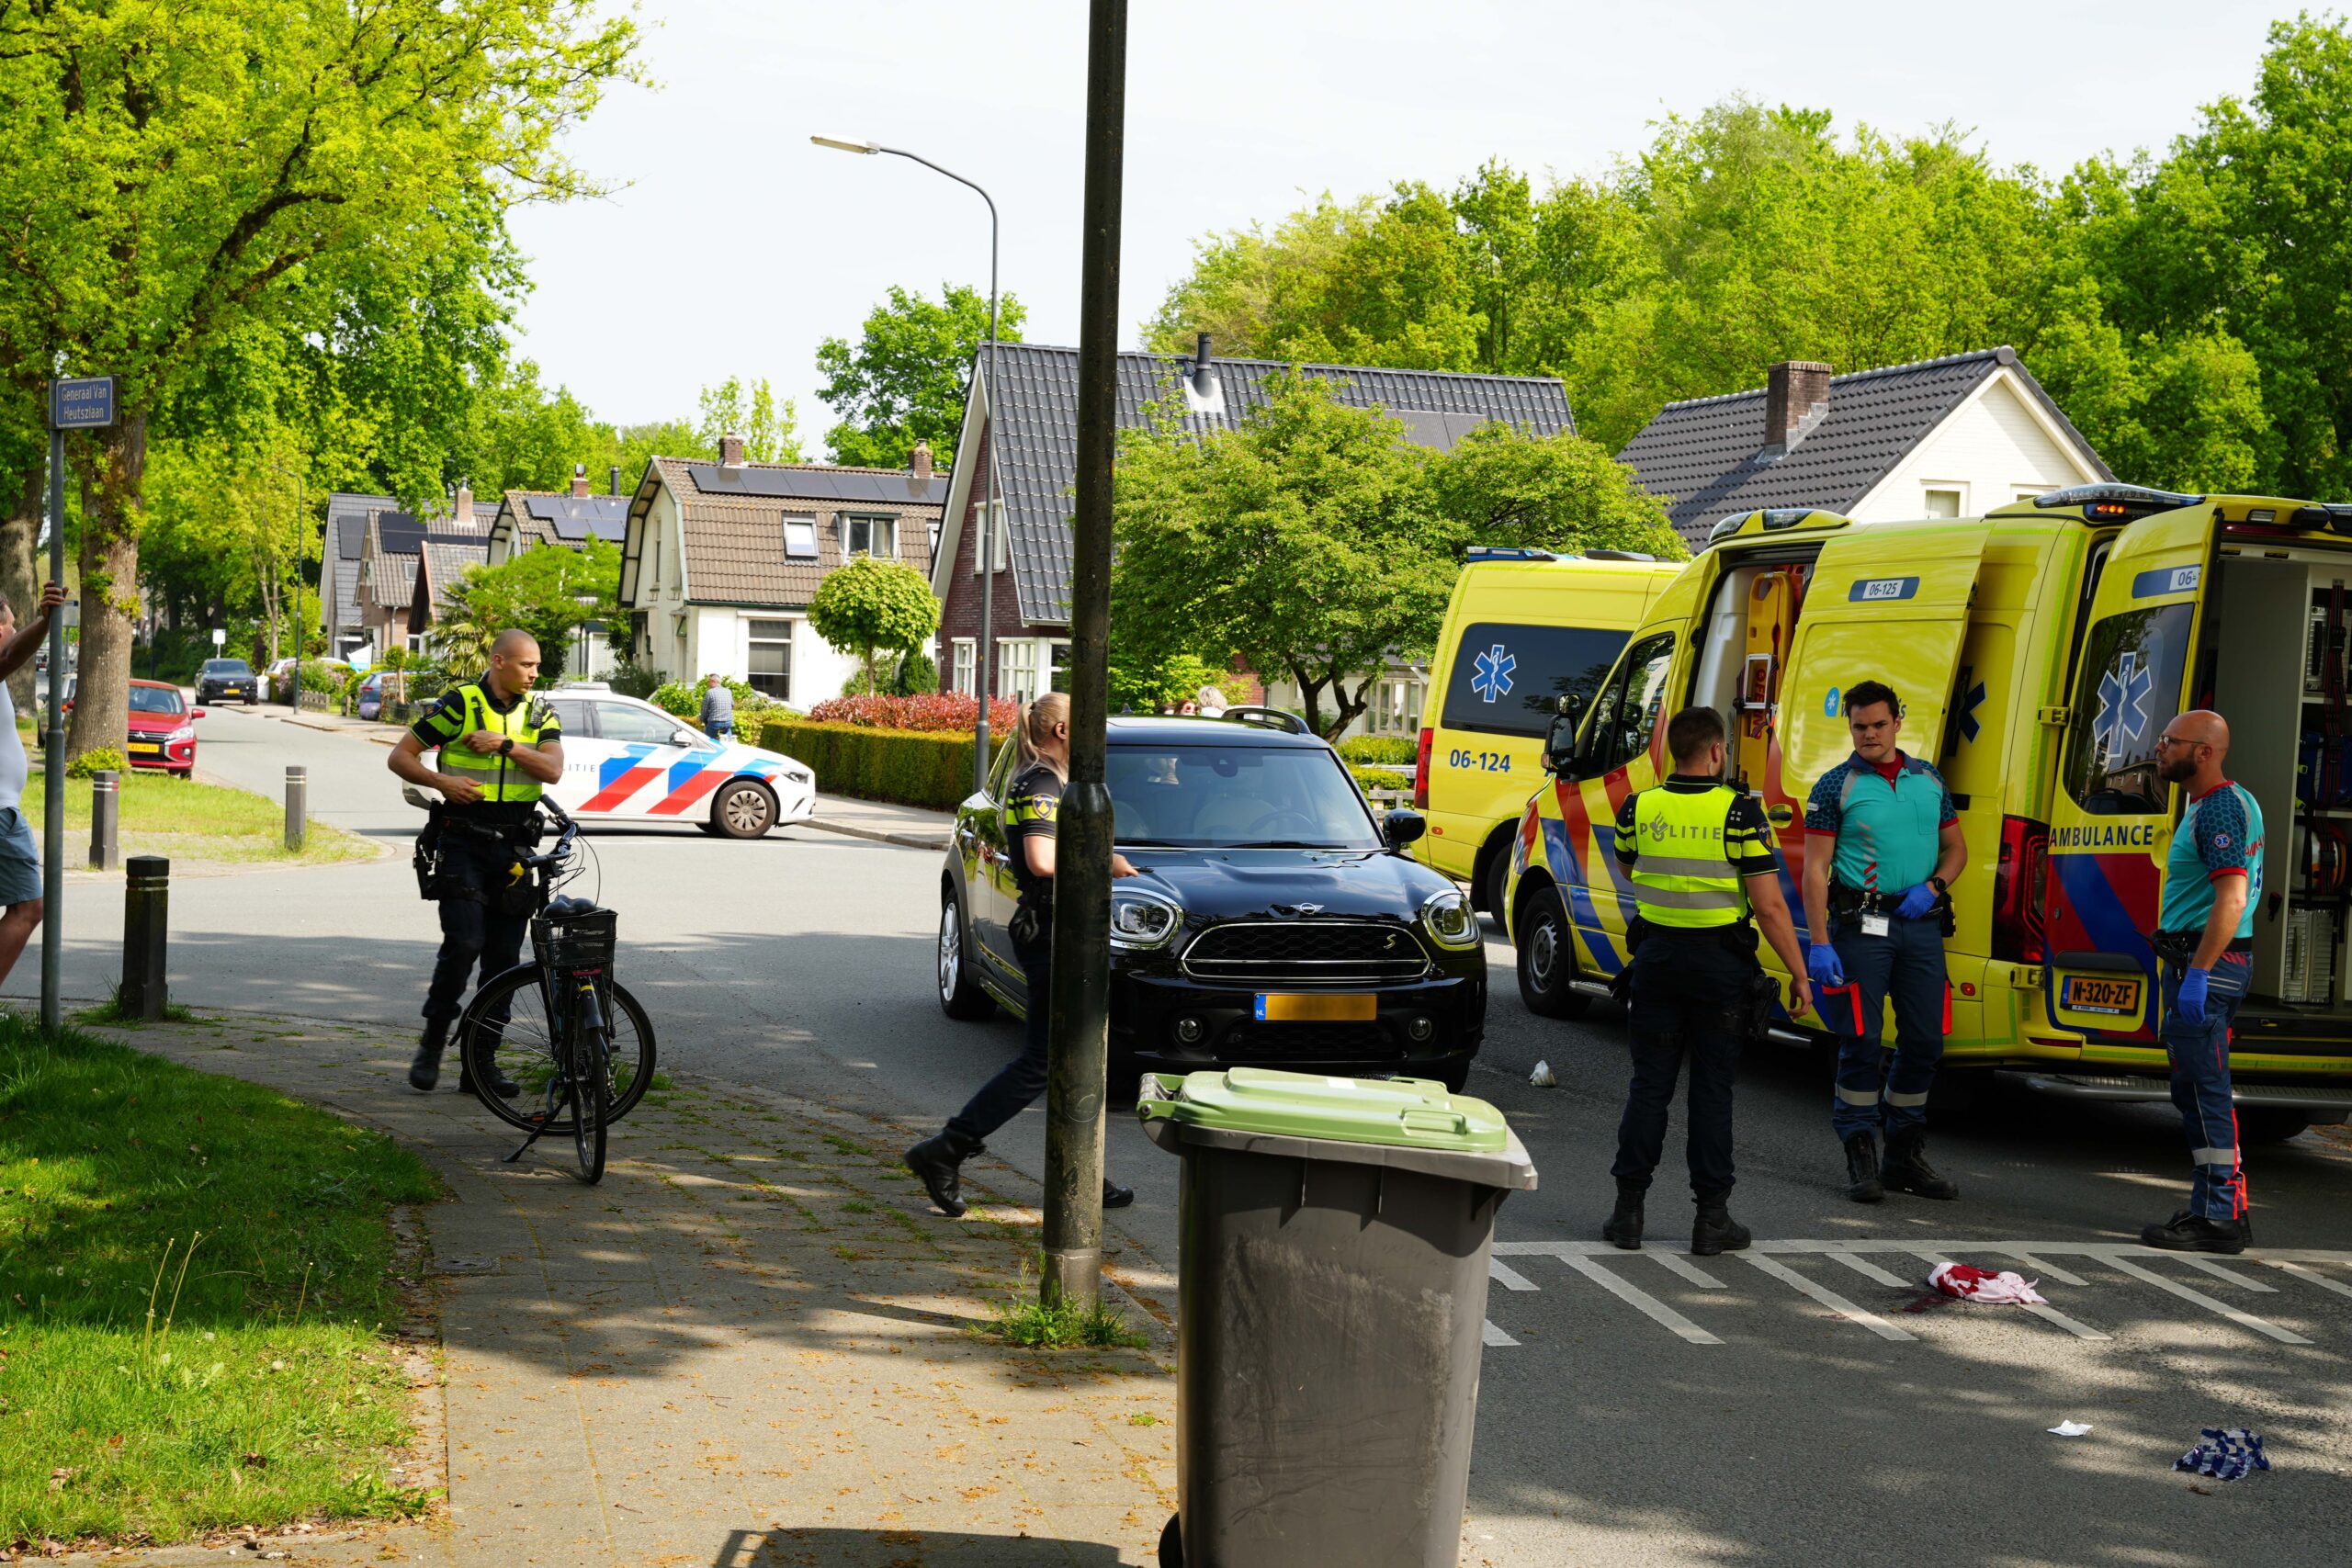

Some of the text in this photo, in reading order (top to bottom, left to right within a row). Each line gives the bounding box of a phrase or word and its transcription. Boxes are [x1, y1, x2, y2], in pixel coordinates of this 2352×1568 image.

[62, 384, 107, 401] Generaal Van
[63, 406, 104, 420] Heutszlaan
[2178, 570, 2200, 586] 06-
[1869, 582, 1897, 596] 06-125
[1752, 682, 1767, 739] FENO
[562, 763, 596, 773] ITIE
[1450, 749, 1510, 773] 06-124
[2049, 825, 2154, 847] AMBULANCE
[2073, 981, 2132, 1006] N-320-ZF
